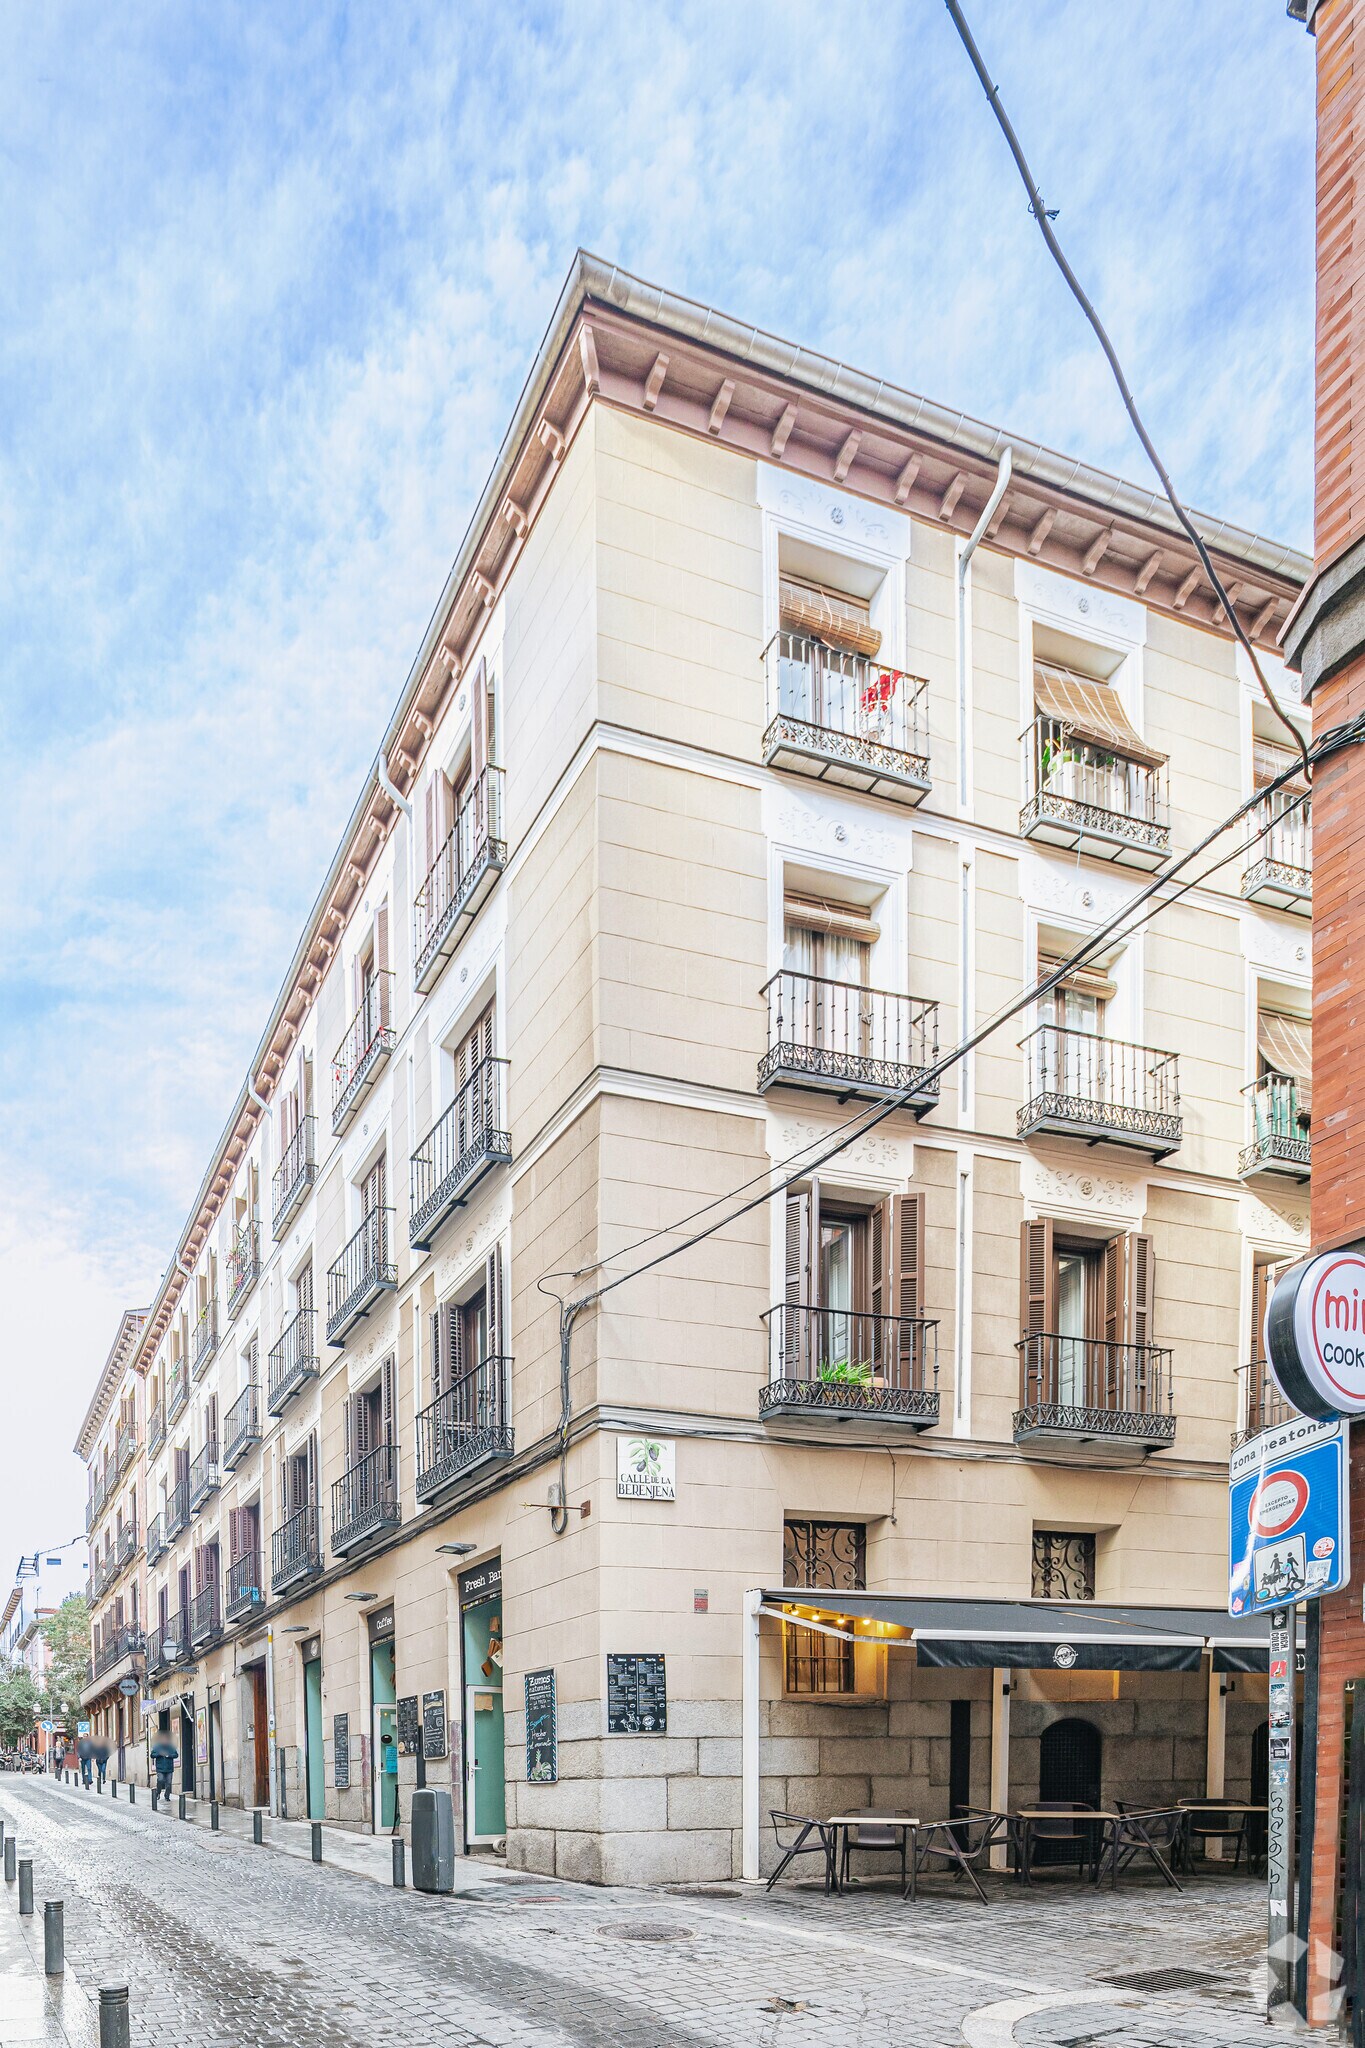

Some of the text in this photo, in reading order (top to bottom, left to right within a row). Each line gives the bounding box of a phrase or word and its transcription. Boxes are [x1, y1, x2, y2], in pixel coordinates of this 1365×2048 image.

[1325, 1288, 1365, 1335] mi
[1233, 1450, 1257, 1470] zona
[620, 1473, 650, 1484] CALLE
[661, 1476, 671, 1485] LA
[618, 1483, 675, 1499] BERENJENA
[1264, 1495, 1289, 1508] EXCEPTO
[464, 1575, 486, 1593] Fresh
[376, 1616, 393, 1630] Coffee
[528, 1674, 551, 1687] Zumos
